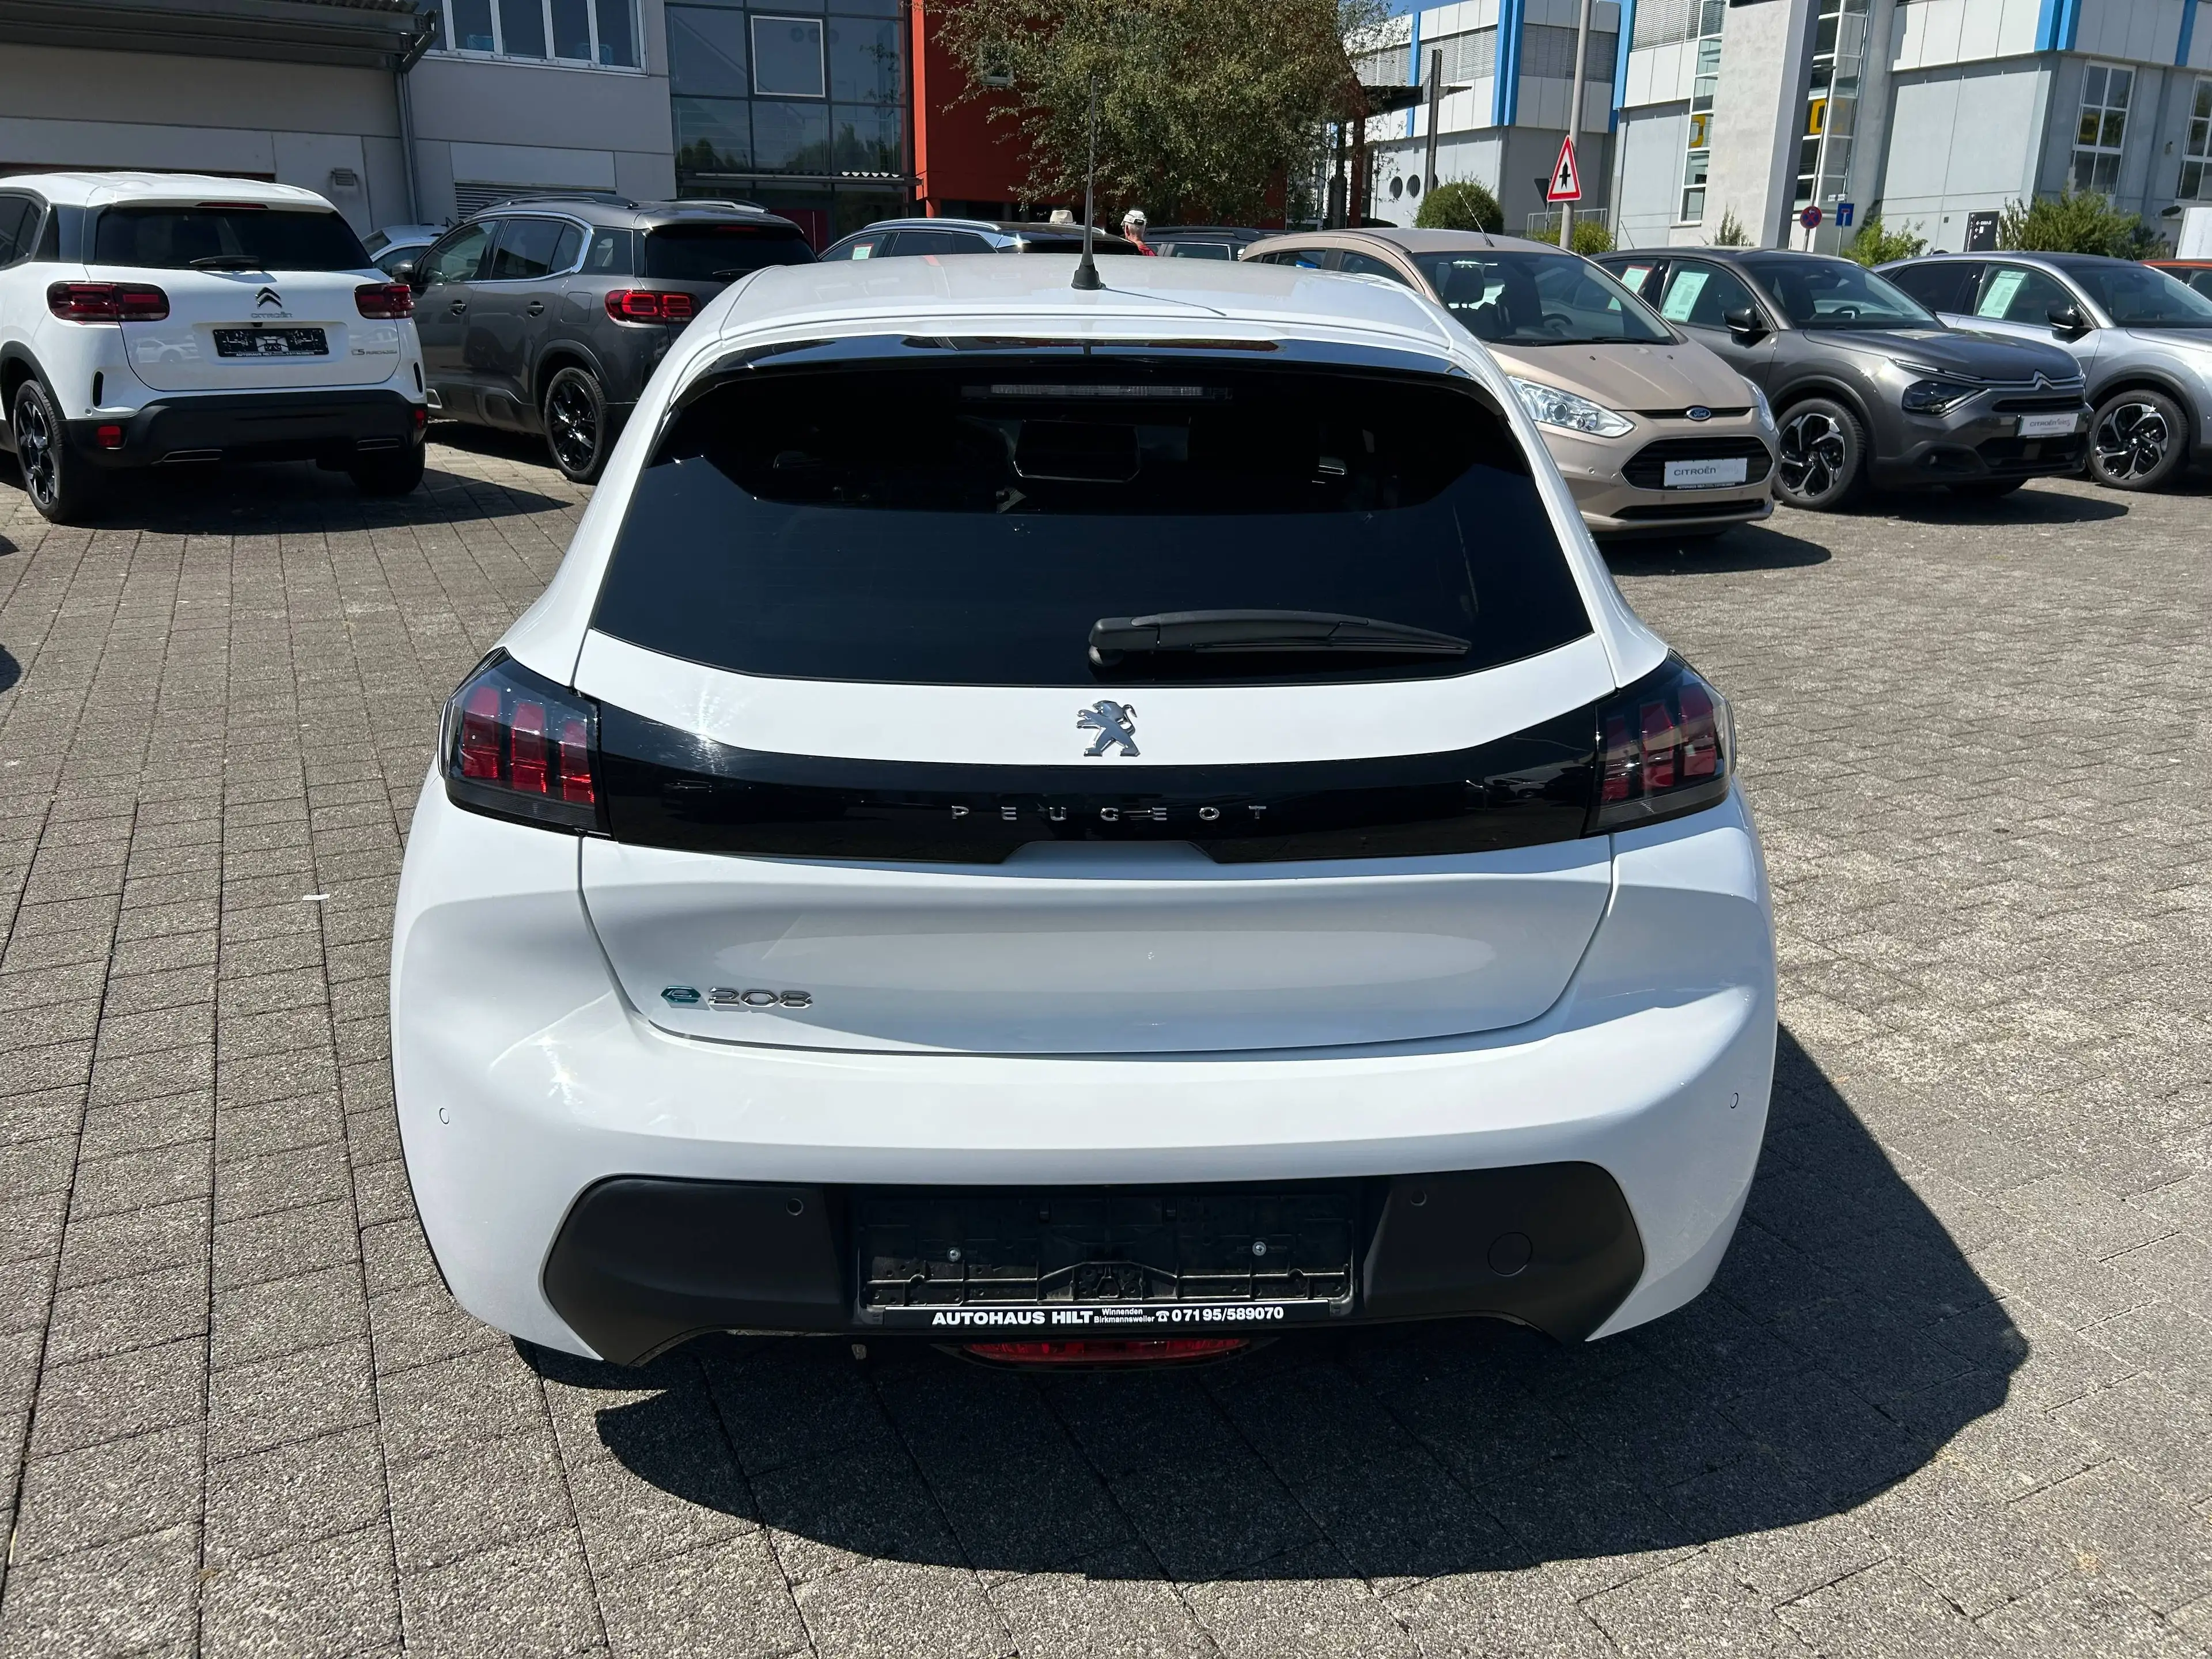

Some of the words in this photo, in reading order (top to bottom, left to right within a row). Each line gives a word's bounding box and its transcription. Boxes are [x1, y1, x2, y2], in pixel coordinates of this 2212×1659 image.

[951, 805, 1267, 821] PEUGEOT
[931, 1311, 1046, 1325] AUTOHAUS
[1052, 1310, 1093, 1324] HILT
[1093, 1315, 1155, 1324] Birkmannsweiler
[1171, 1306, 1285, 1322] 07195/589070
